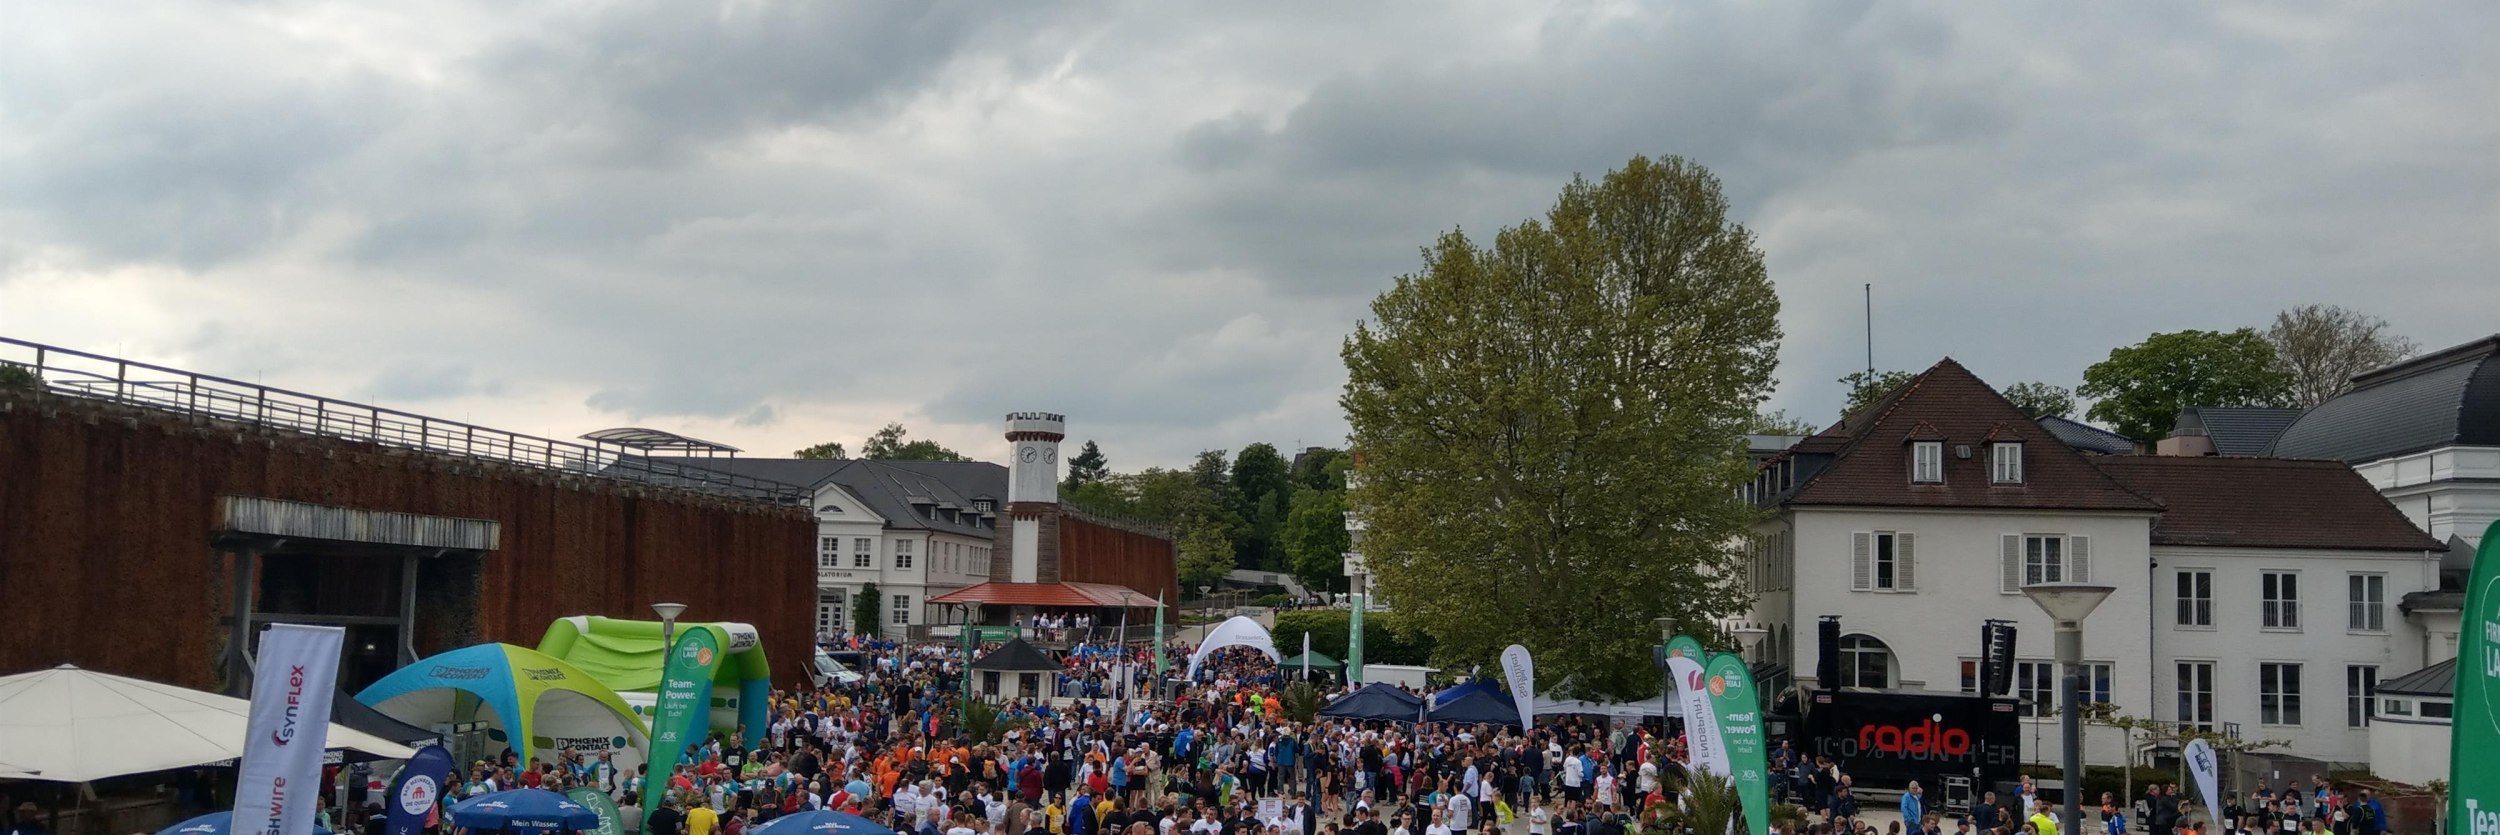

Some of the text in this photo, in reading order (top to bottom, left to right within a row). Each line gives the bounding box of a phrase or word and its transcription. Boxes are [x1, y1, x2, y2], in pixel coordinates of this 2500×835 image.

[668, 680, 696, 688] Team-
[665, 691, 696, 699] Power.
[1859, 713, 1970, 755] radio
[1958, 744, 2016, 765] HER
[2466, 798, 2500, 835] Tea
[532, 820, 559, 828] Wasser.
